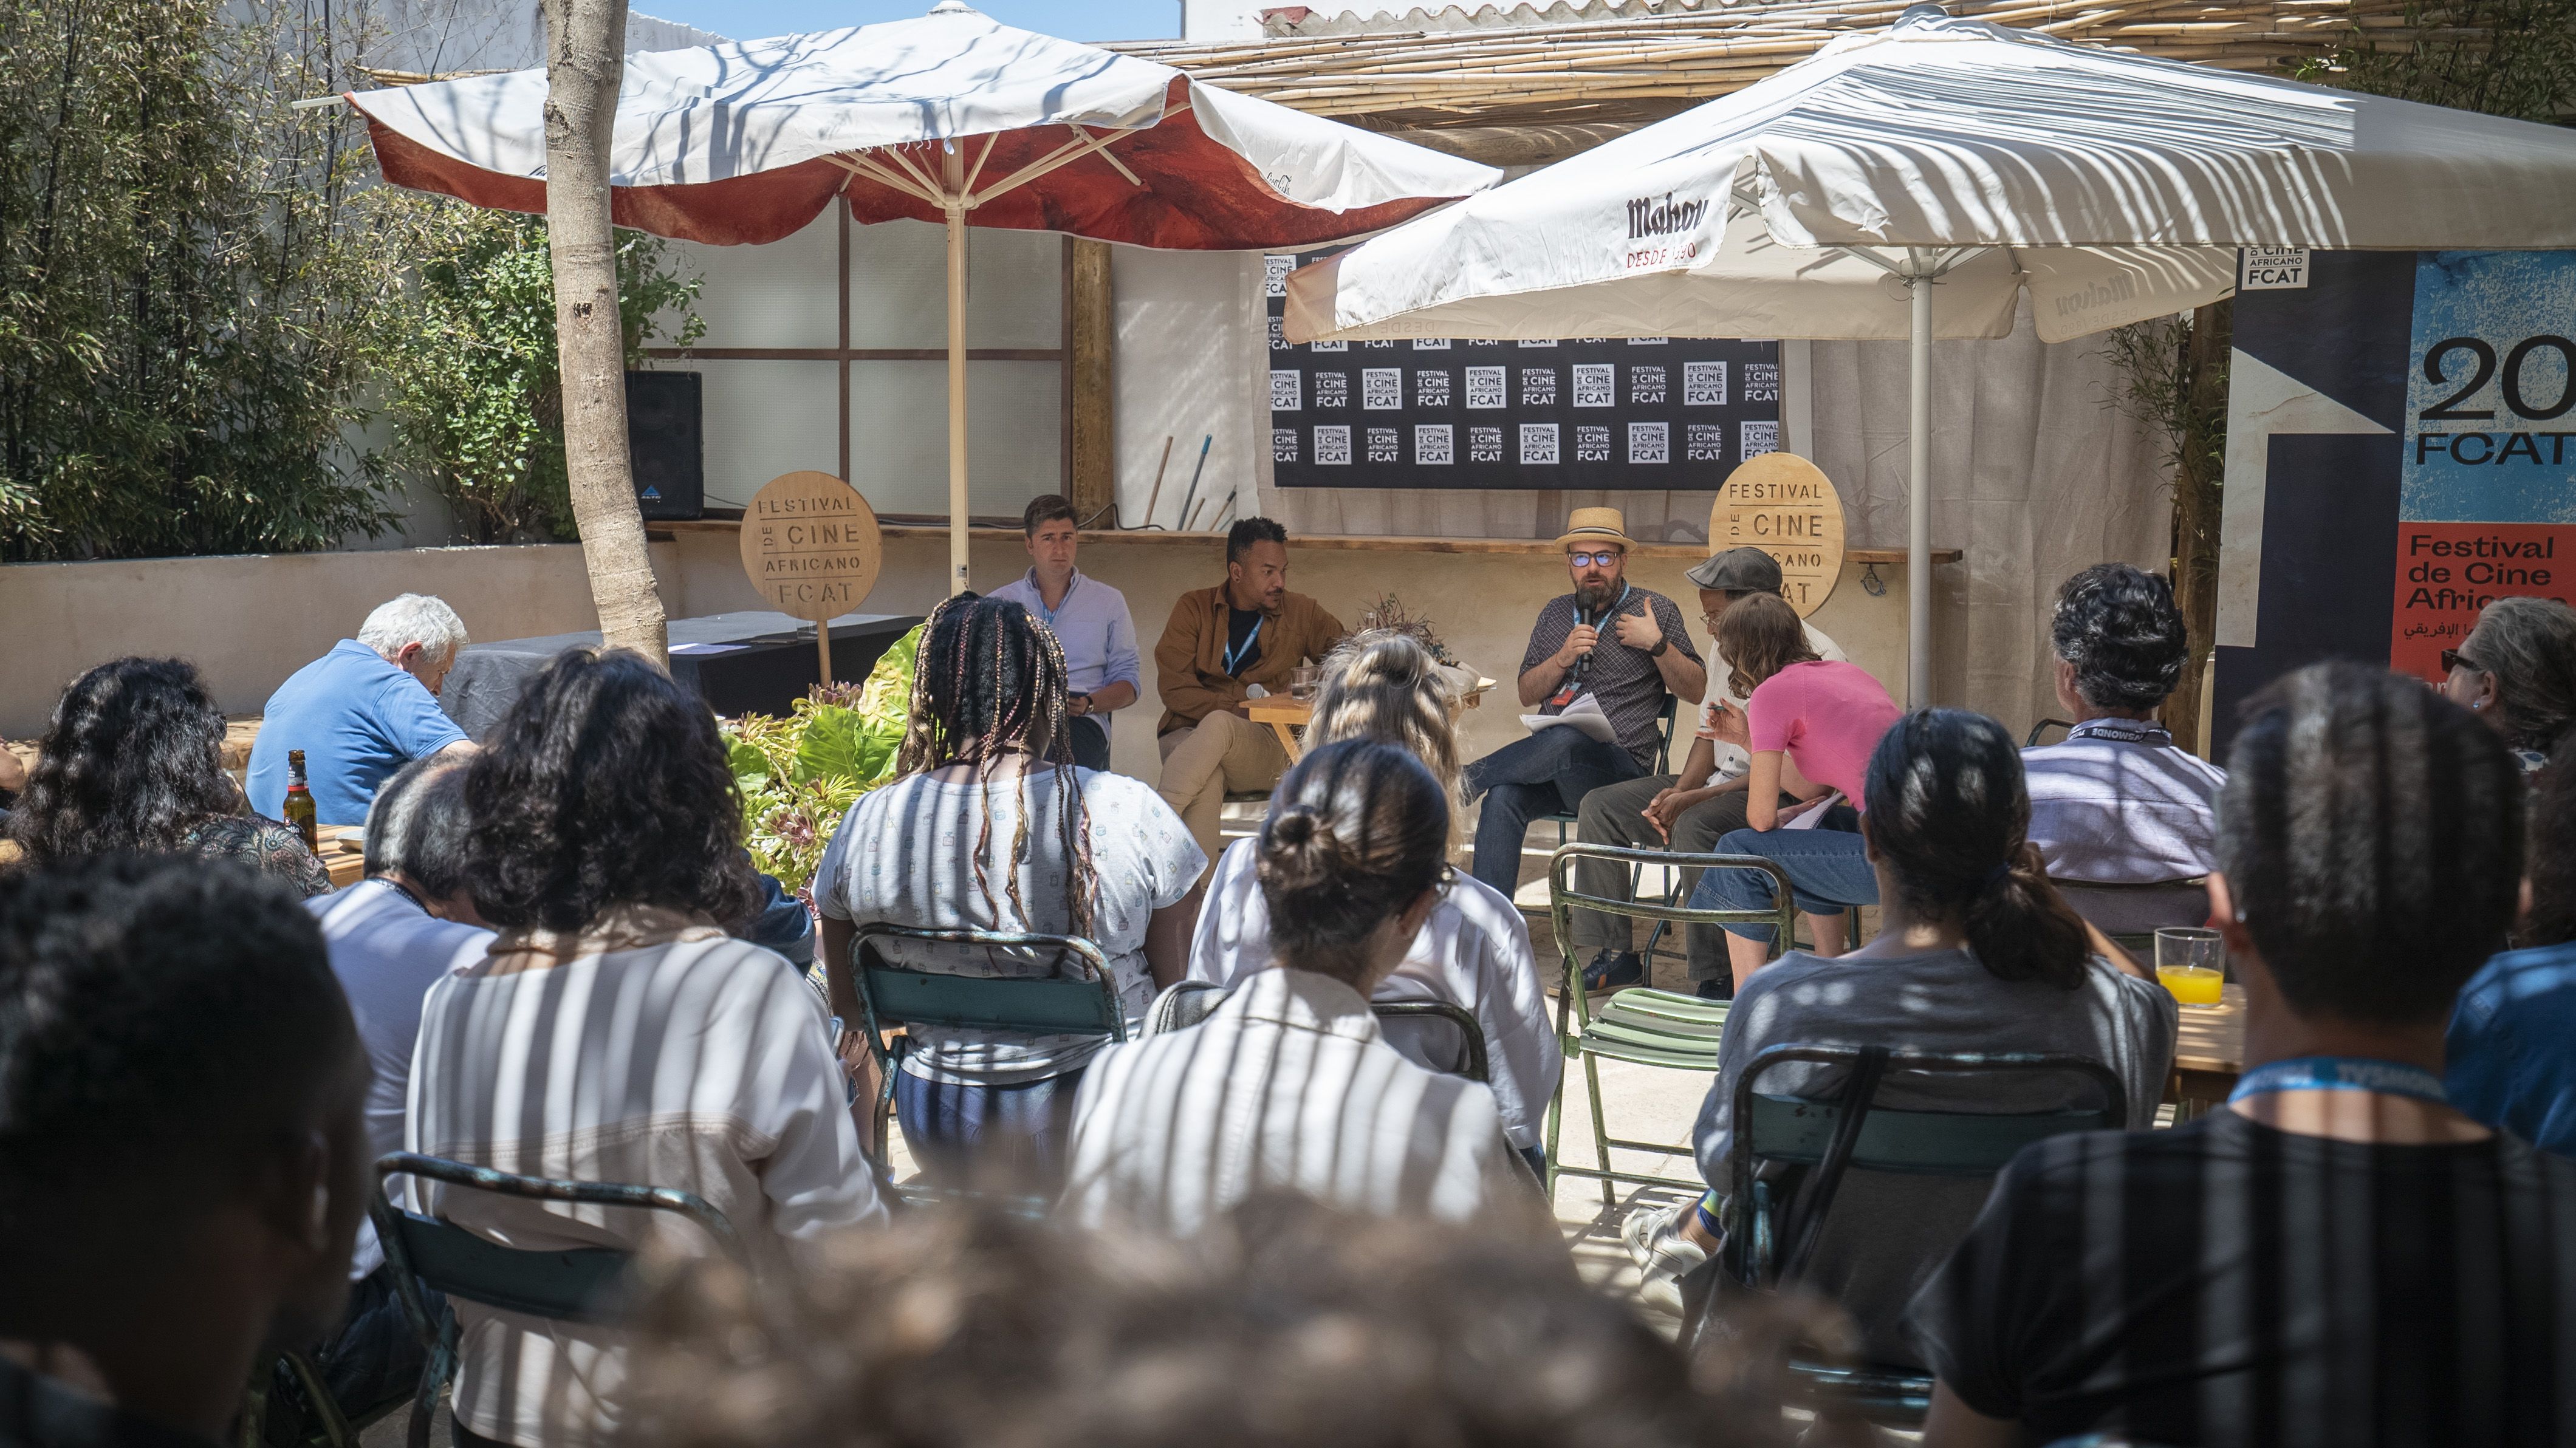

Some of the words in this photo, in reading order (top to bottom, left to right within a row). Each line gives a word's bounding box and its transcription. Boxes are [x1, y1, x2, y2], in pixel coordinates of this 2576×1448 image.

[1626, 191, 1709, 239] Mahou
[1627, 248, 1667, 268] DESDE
[2250, 258, 2303, 267] AFRICANO
[2249, 268, 2302, 284] FCAT
[1530, 377, 1555, 385] CINE
[1640, 374, 1666, 383] CINE
[1697, 373, 1722, 381] CINE
[1753, 372, 1778, 381] CINE
[2419, 335, 2576, 420] 20
[1323, 380, 1347, 388] CINE
[1425, 378, 1450, 387] CINE
[1418, 395, 1450, 406] FCAT
[1470, 395, 1502, 405] FCAT
[1523, 394, 1555, 405] FCAT
[1577, 394, 1610, 403] FCAT
[1632, 392, 1666, 403] FCAT
[1688, 391, 1722, 401] FCAT
[1317, 397, 1348, 407] FCAT
[1368, 397, 1397, 406] FCAT
[2416, 432, 2576, 465] FCAT
[1318, 452, 1347, 462] FCAT
[1368, 452, 1398, 462] FCAT
[1419, 452, 1449, 461] FCAT
[1471, 451, 1502, 461] FCAT
[1524, 451, 1555, 460] FCAT
[1577, 451, 1609, 460] FCAT
[1632, 451, 1665, 460] FCAT
[1688, 450, 1721, 460] FCAT
[1730, 484, 1822, 499] FESTIVAL
[758, 497, 855, 513] FESTIVAL
[1730, 514, 1740, 535] DE
[1753, 514, 1822, 536] CINE
[762, 527, 773, 546] DE
[787, 524, 859, 544] CINE
[2410, 535, 2554, 559] Festival
[766, 557, 860, 572] AFRICANO
[2408, 562, 2451, 583] de
[2465, 562, 2551, 586] Cine
[779, 583, 852, 603] FCAT
[2403, 622, 2458, 640] الإفريقي
